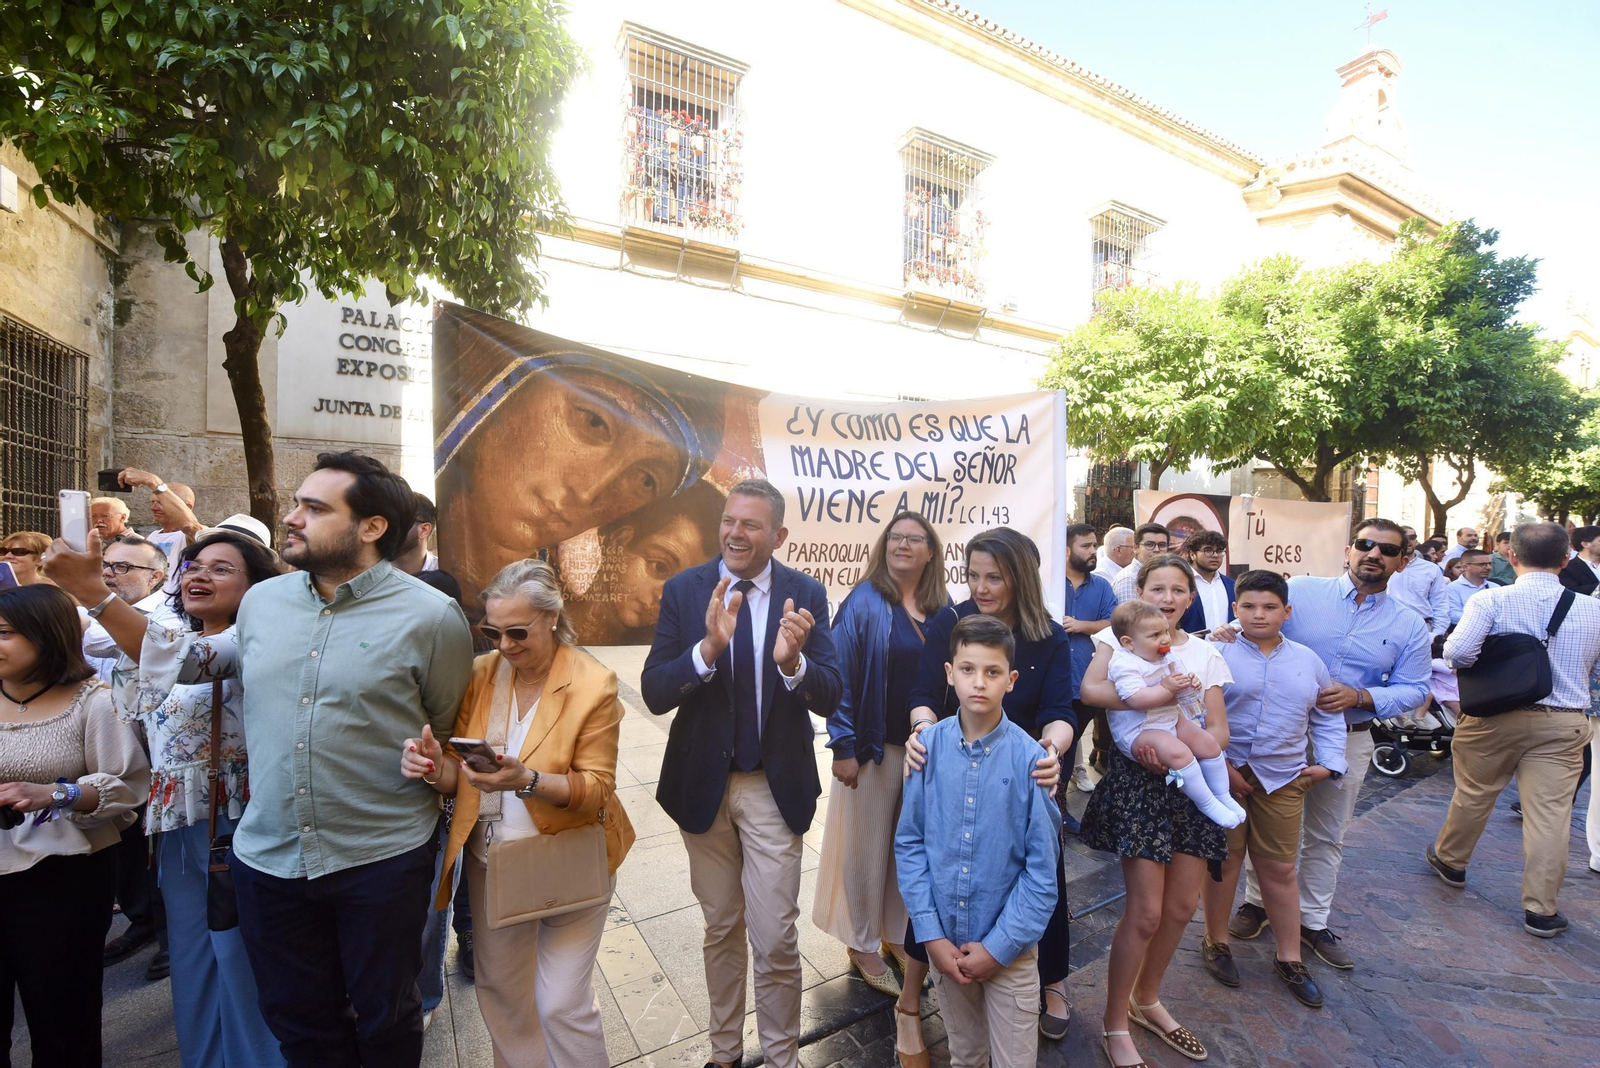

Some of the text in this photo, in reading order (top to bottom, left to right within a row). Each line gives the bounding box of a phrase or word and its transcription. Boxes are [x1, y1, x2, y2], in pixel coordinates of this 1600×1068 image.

[338, 333, 432, 360] CONGRE
[314, 398, 374, 416] JUNTA
[380, 404, 402, 419] DE
[786, 406, 1031, 444] ¿Y COMO ES QUE LA
[790, 444, 1018, 484] MADRE DEL SEÑOR
[797, 482, 964, 524] VIENE A MÍ?
[786, 542, 965, 562] PARROQUIA AN
[1264, 545, 1302, 564] ERES
[604, 573, 618, 582] LA
[582, 592, 630, 602] NAZARET
